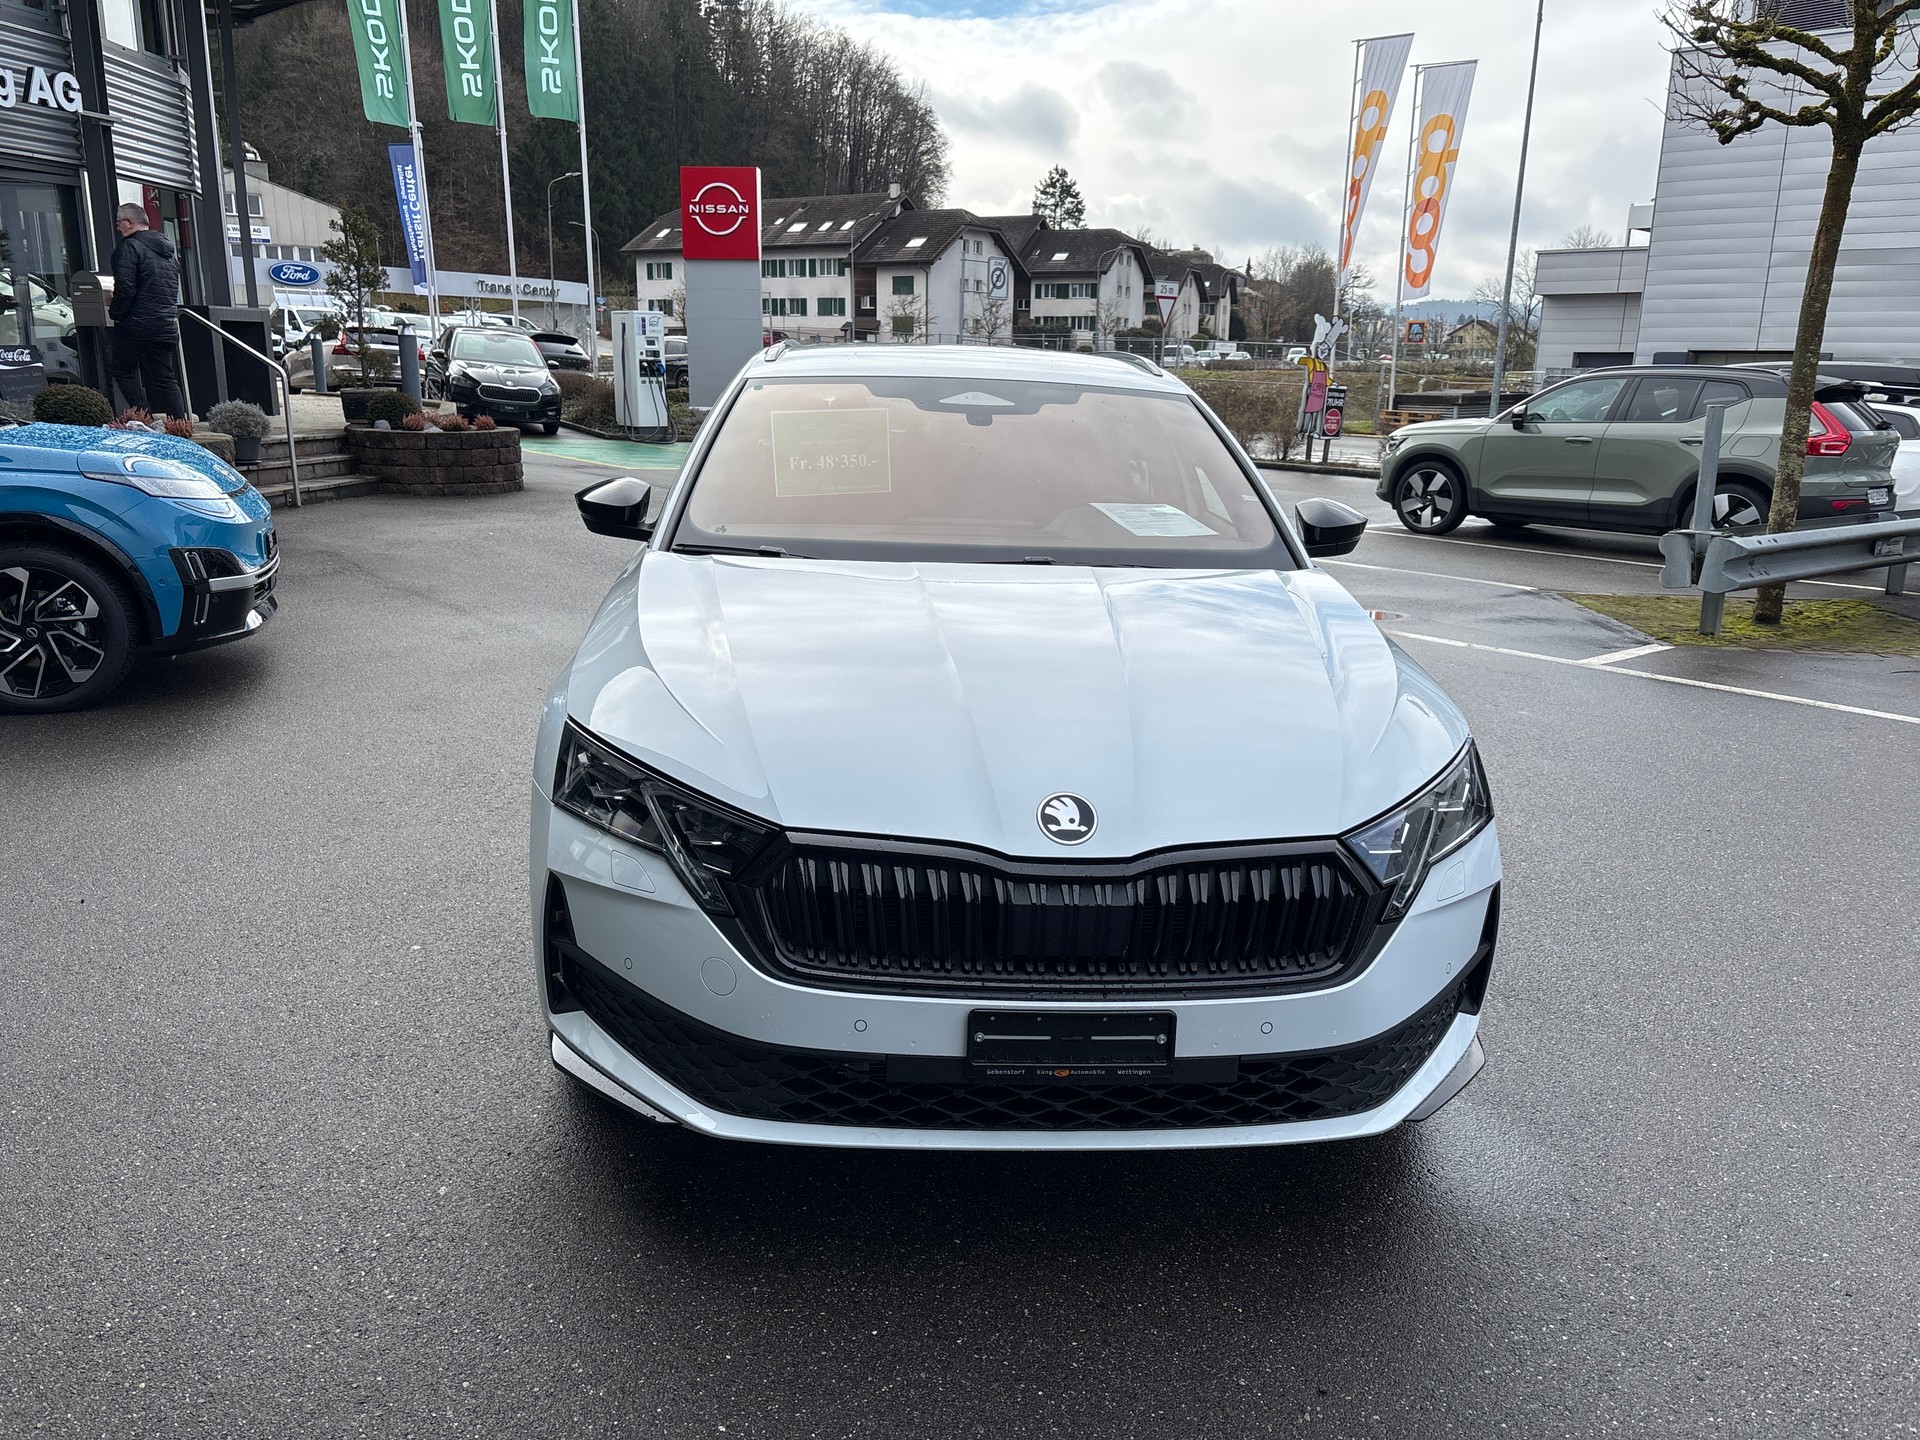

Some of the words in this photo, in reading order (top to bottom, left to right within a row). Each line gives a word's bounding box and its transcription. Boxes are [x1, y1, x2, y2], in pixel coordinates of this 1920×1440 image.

[28, 66, 83, 113] AG
[689, 204, 749, 214] NISSAN
[1405, 113, 1459, 289] coop
[280, 265, 310, 281] Ford
[478, 280, 518, 294] Transt
[522, 283, 560, 296] Center
[789, 456, 812, 470] Fr.
